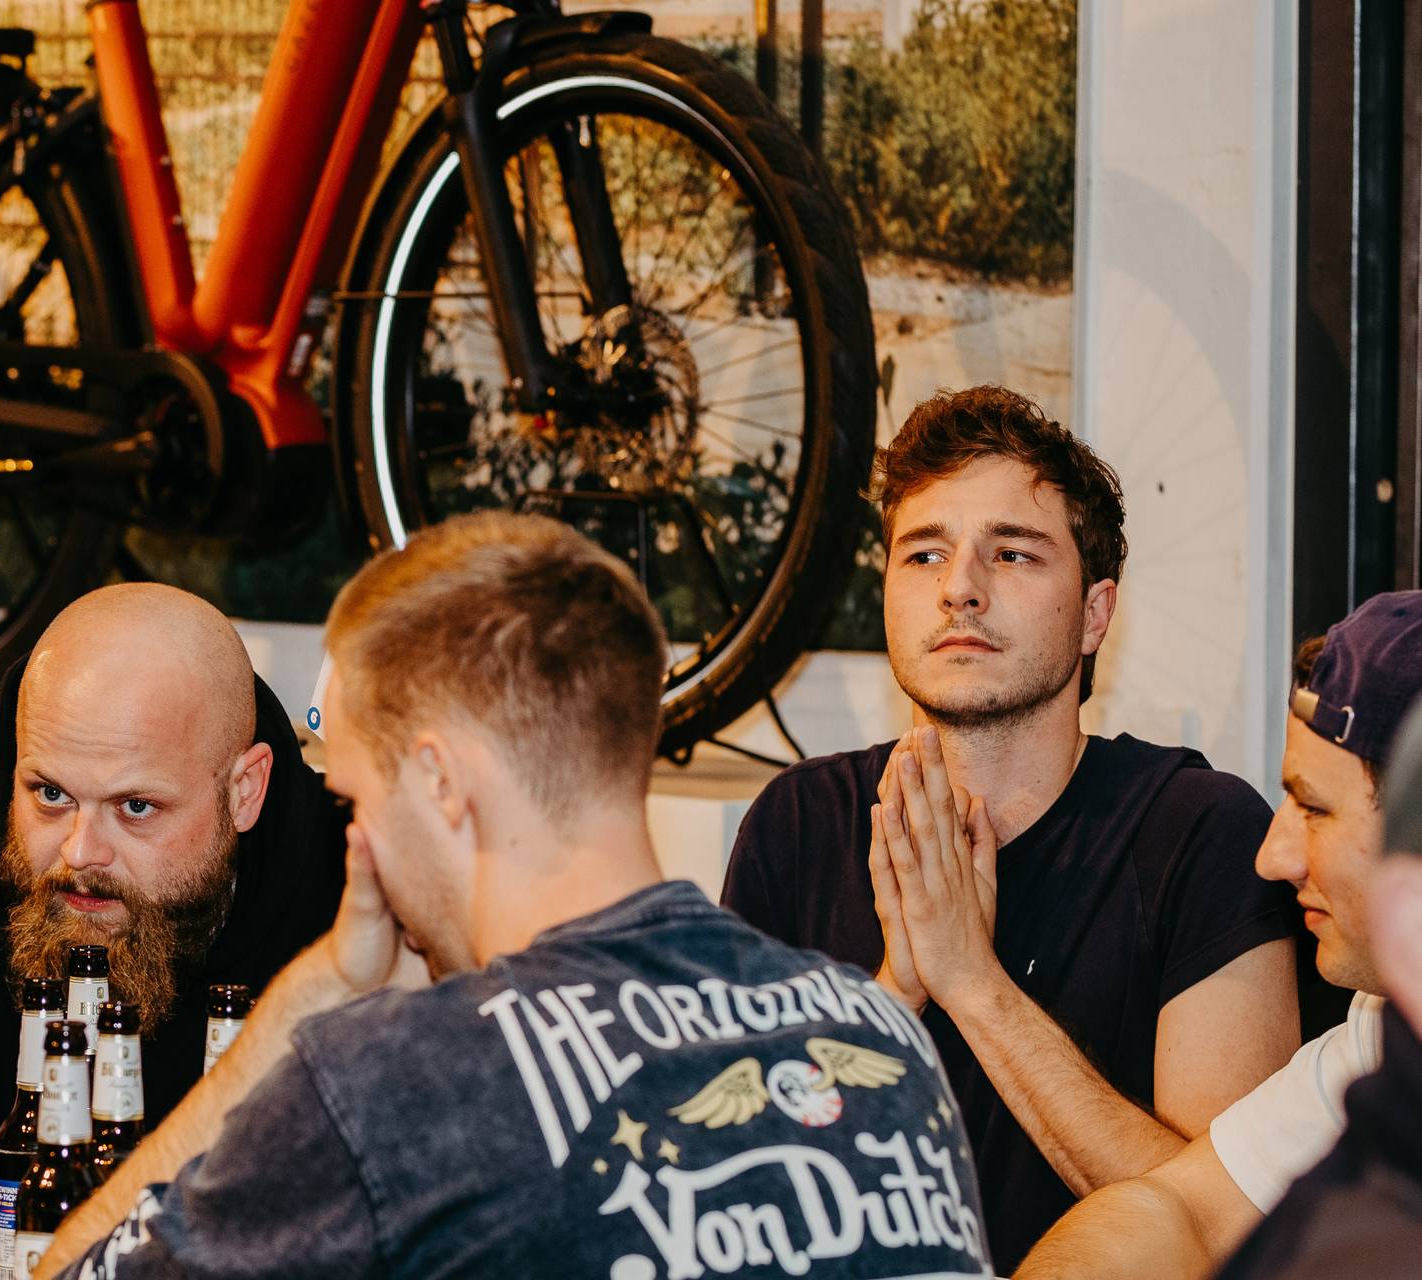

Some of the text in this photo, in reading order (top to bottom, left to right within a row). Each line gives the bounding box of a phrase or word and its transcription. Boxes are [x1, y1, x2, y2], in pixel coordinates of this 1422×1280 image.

[478, 983, 643, 1169] THE
[598, 1130, 981, 1280] Von Dutch
